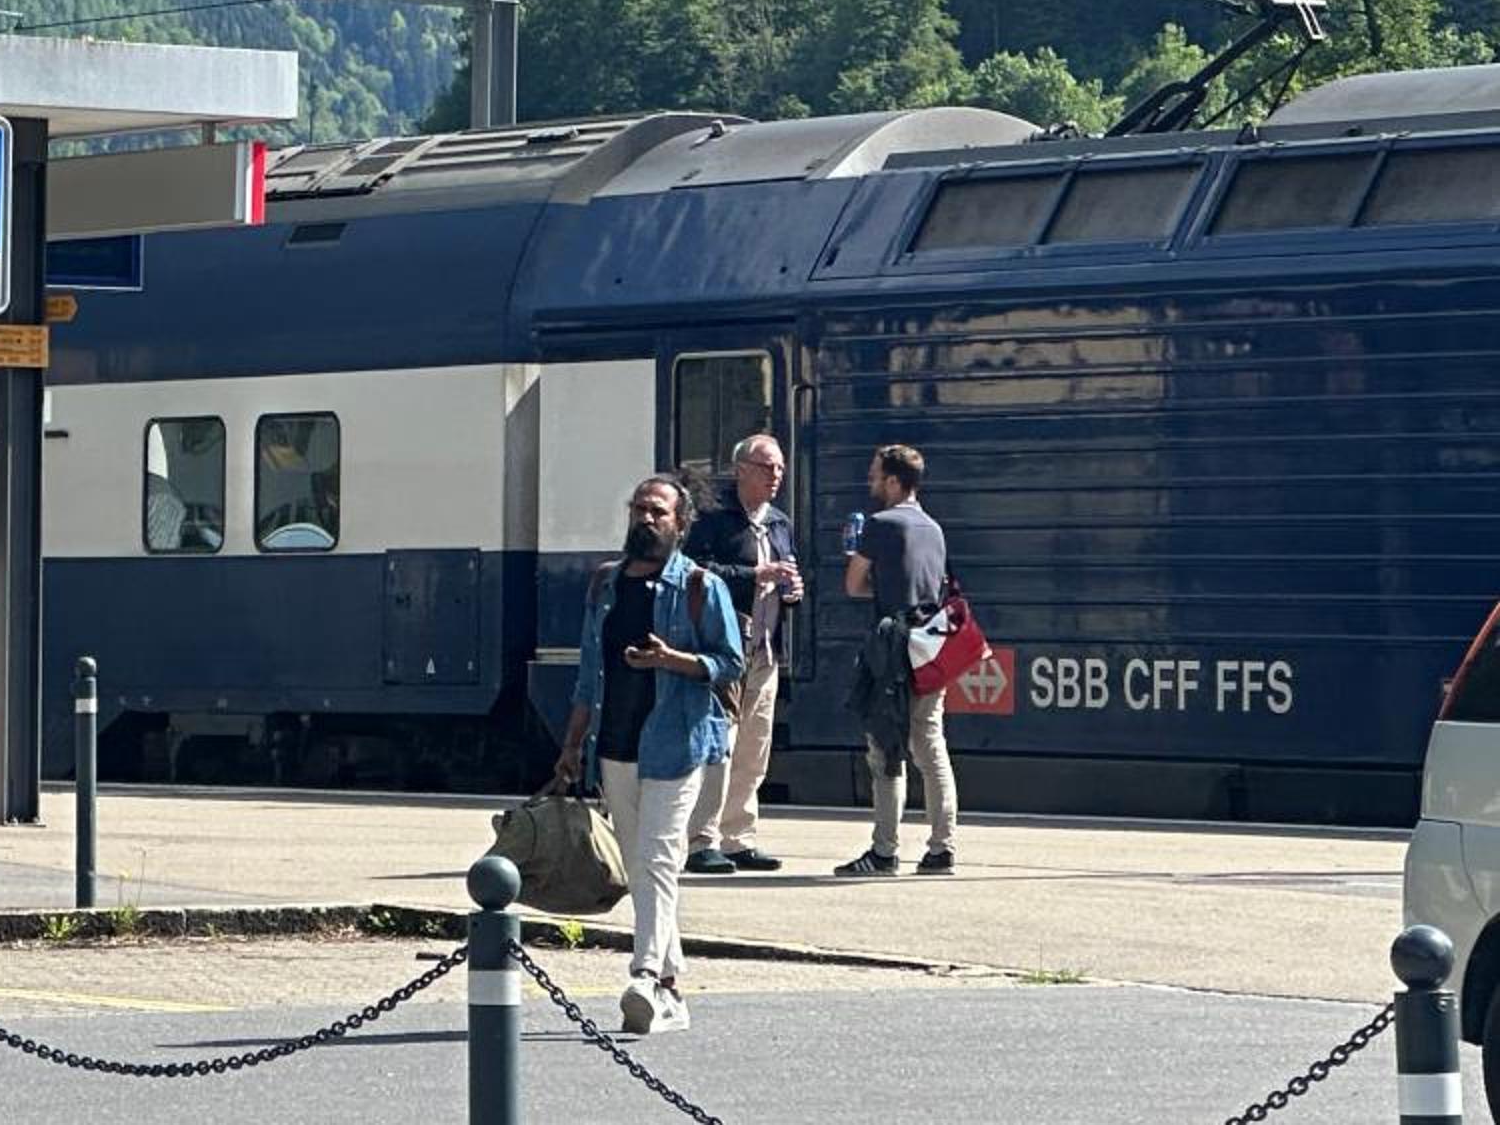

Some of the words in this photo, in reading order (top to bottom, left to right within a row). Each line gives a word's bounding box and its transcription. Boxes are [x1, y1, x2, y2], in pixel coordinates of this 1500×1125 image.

[1030, 656, 1109, 708] SBB
[1123, 658, 1200, 711] CFF
[1216, 660, 1293, 714] FFS
